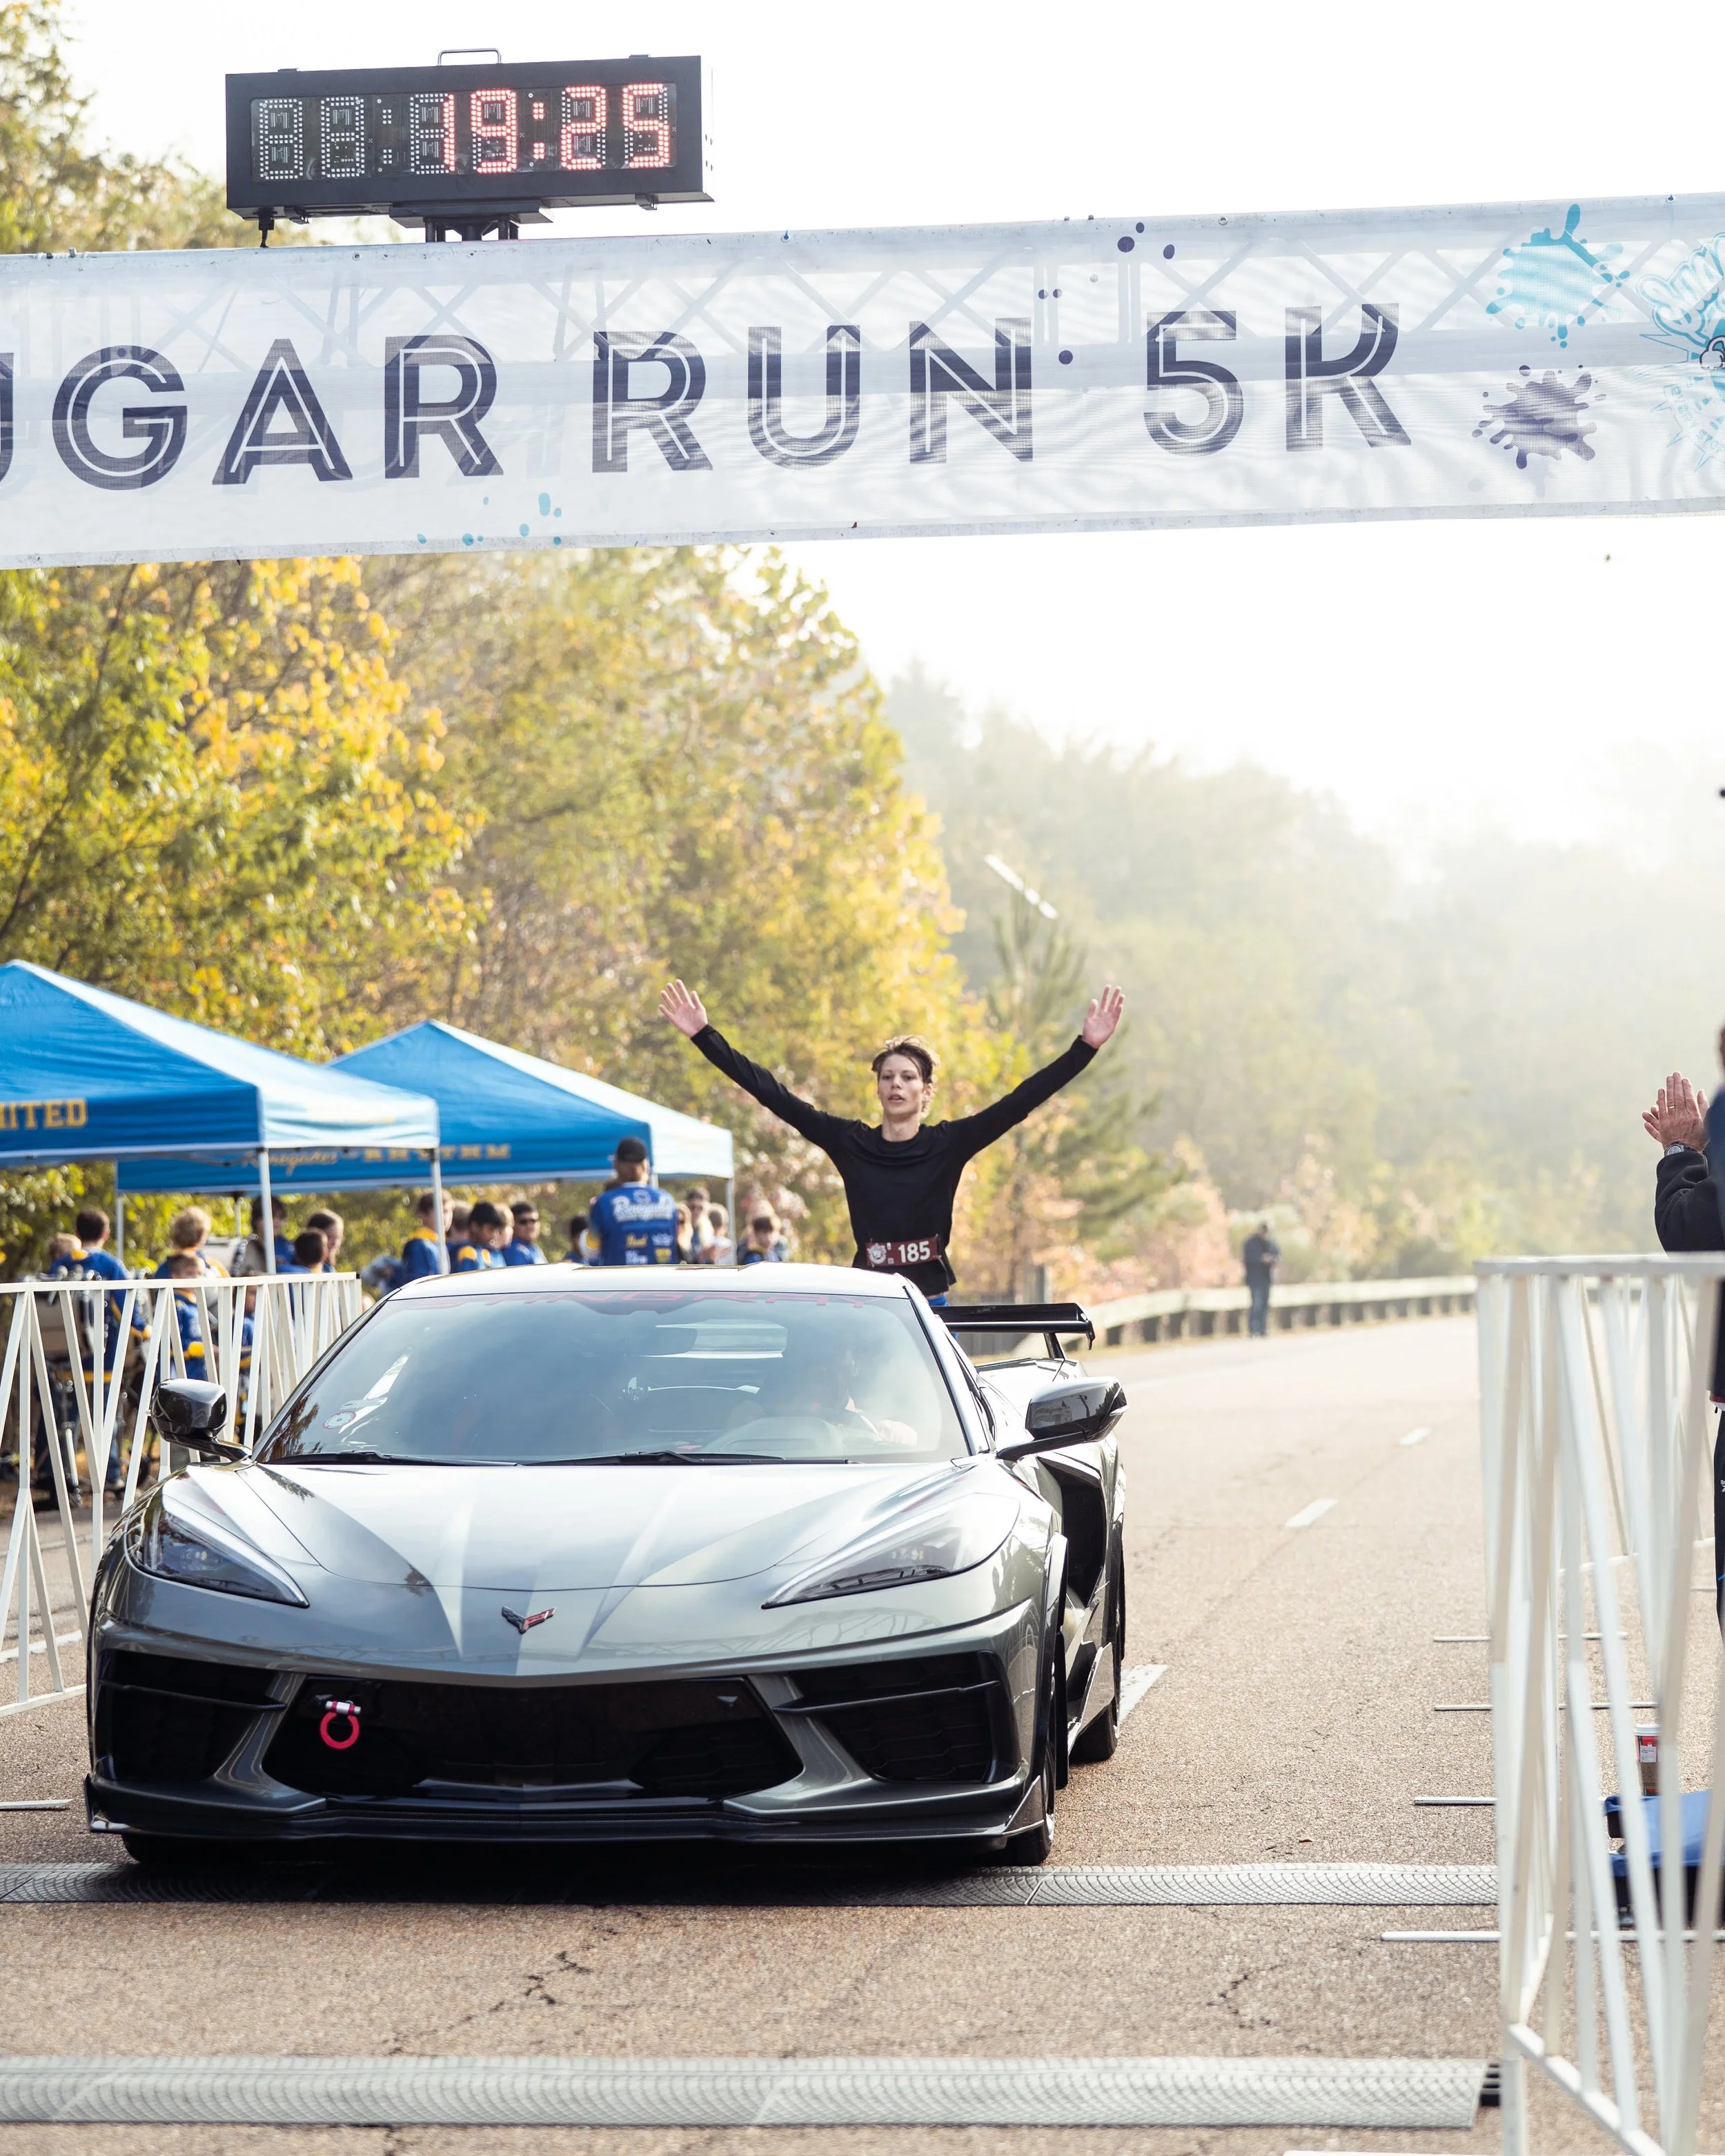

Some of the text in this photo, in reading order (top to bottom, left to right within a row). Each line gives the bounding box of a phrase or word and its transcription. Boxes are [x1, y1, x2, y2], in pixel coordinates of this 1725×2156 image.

[442, 82, 671, 175] 19:25
[0, 302, 1412, 491] GAR RUN 5K
[898, 1240, 930, 1263] 185
